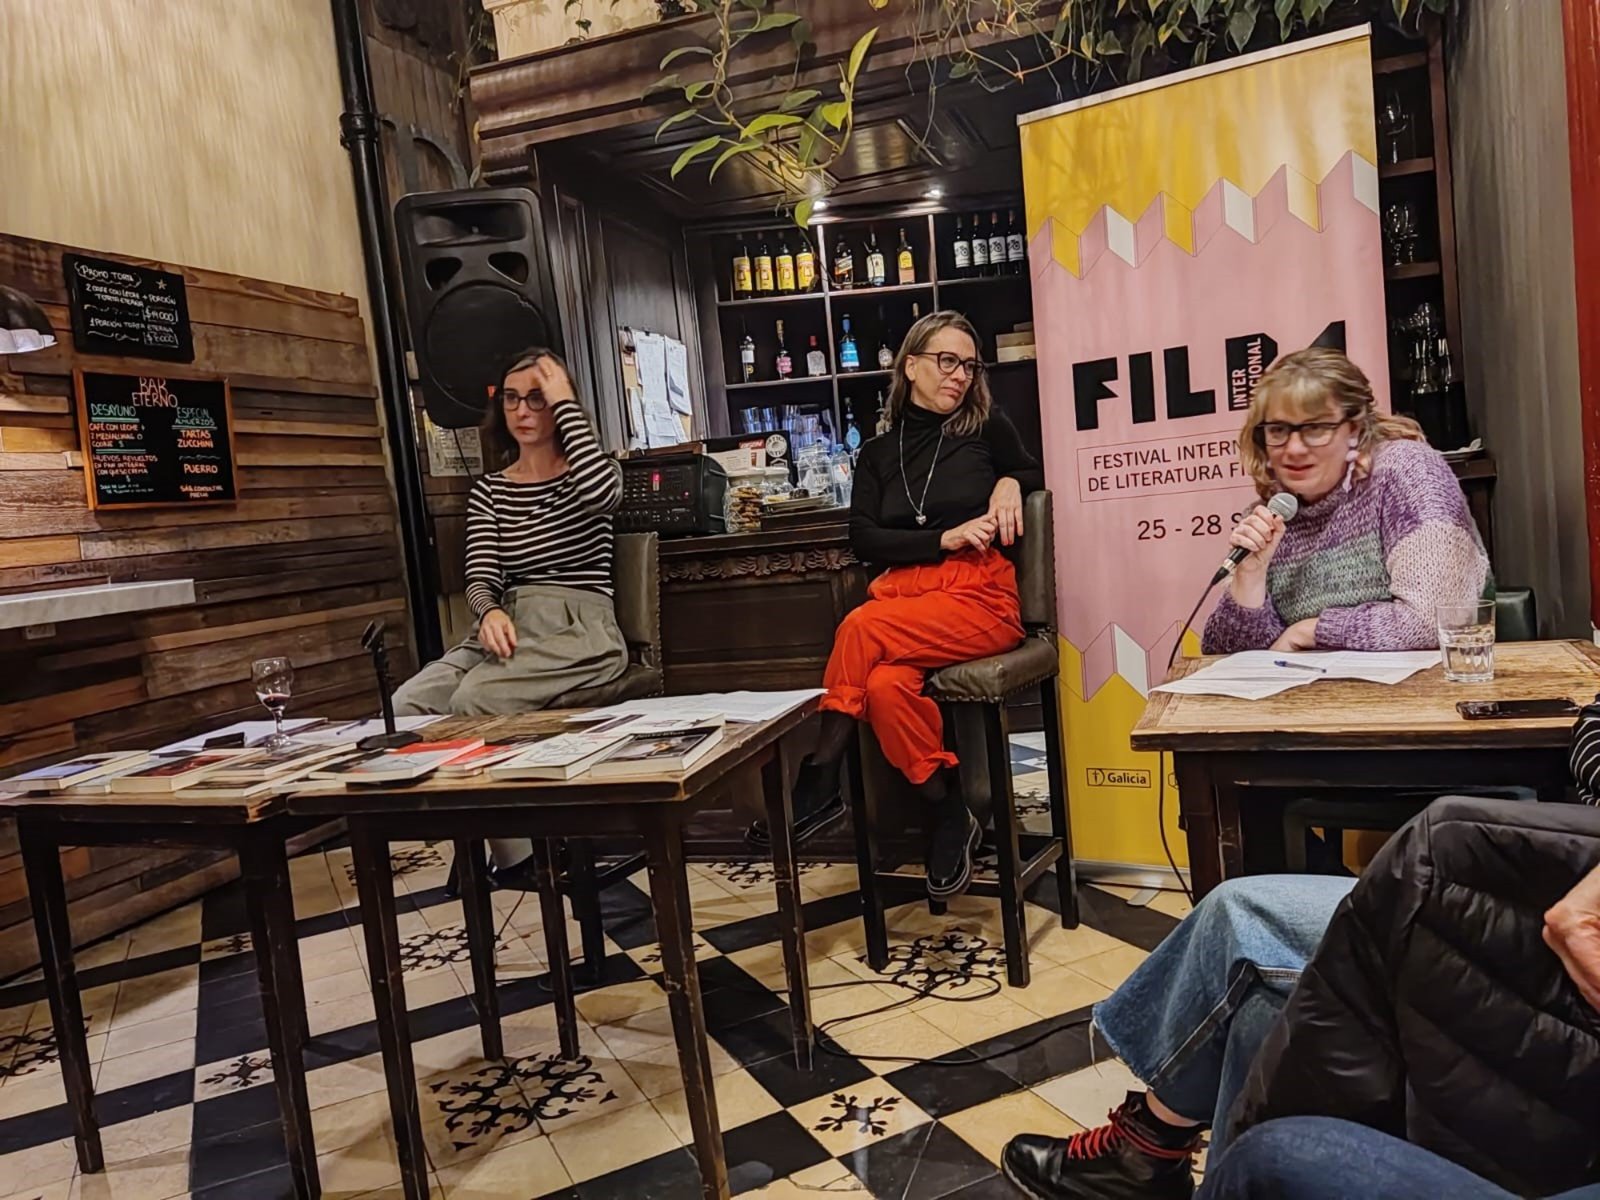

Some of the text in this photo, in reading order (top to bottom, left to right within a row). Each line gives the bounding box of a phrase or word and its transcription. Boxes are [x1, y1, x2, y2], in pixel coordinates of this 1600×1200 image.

[80, 265, 134, 281] PROMO TORTA
[86, 283, 92, 292] 2
[140, 377, 168, 395] BAR
[1231, 368, 1248, 408] INTER
[132, 392, 178, 408] ETERNO
[90, 402, 136, 417] DESAYUNO
[180, 429, 211, 439] TARTAS
[177, 439, 214, 448] ZUCCHINI
[1093, 439, 1241, 471] FESTIVAL INTERN
[184, 464, 218, 474] PUERRO
[1088, 461, 1245, 492] DE LITERATURA FI
[1137, 519, 1167, 541] 25
[1191, 514, 1222, 537] 28
[1107, 772, 1147, 785] Galicia
